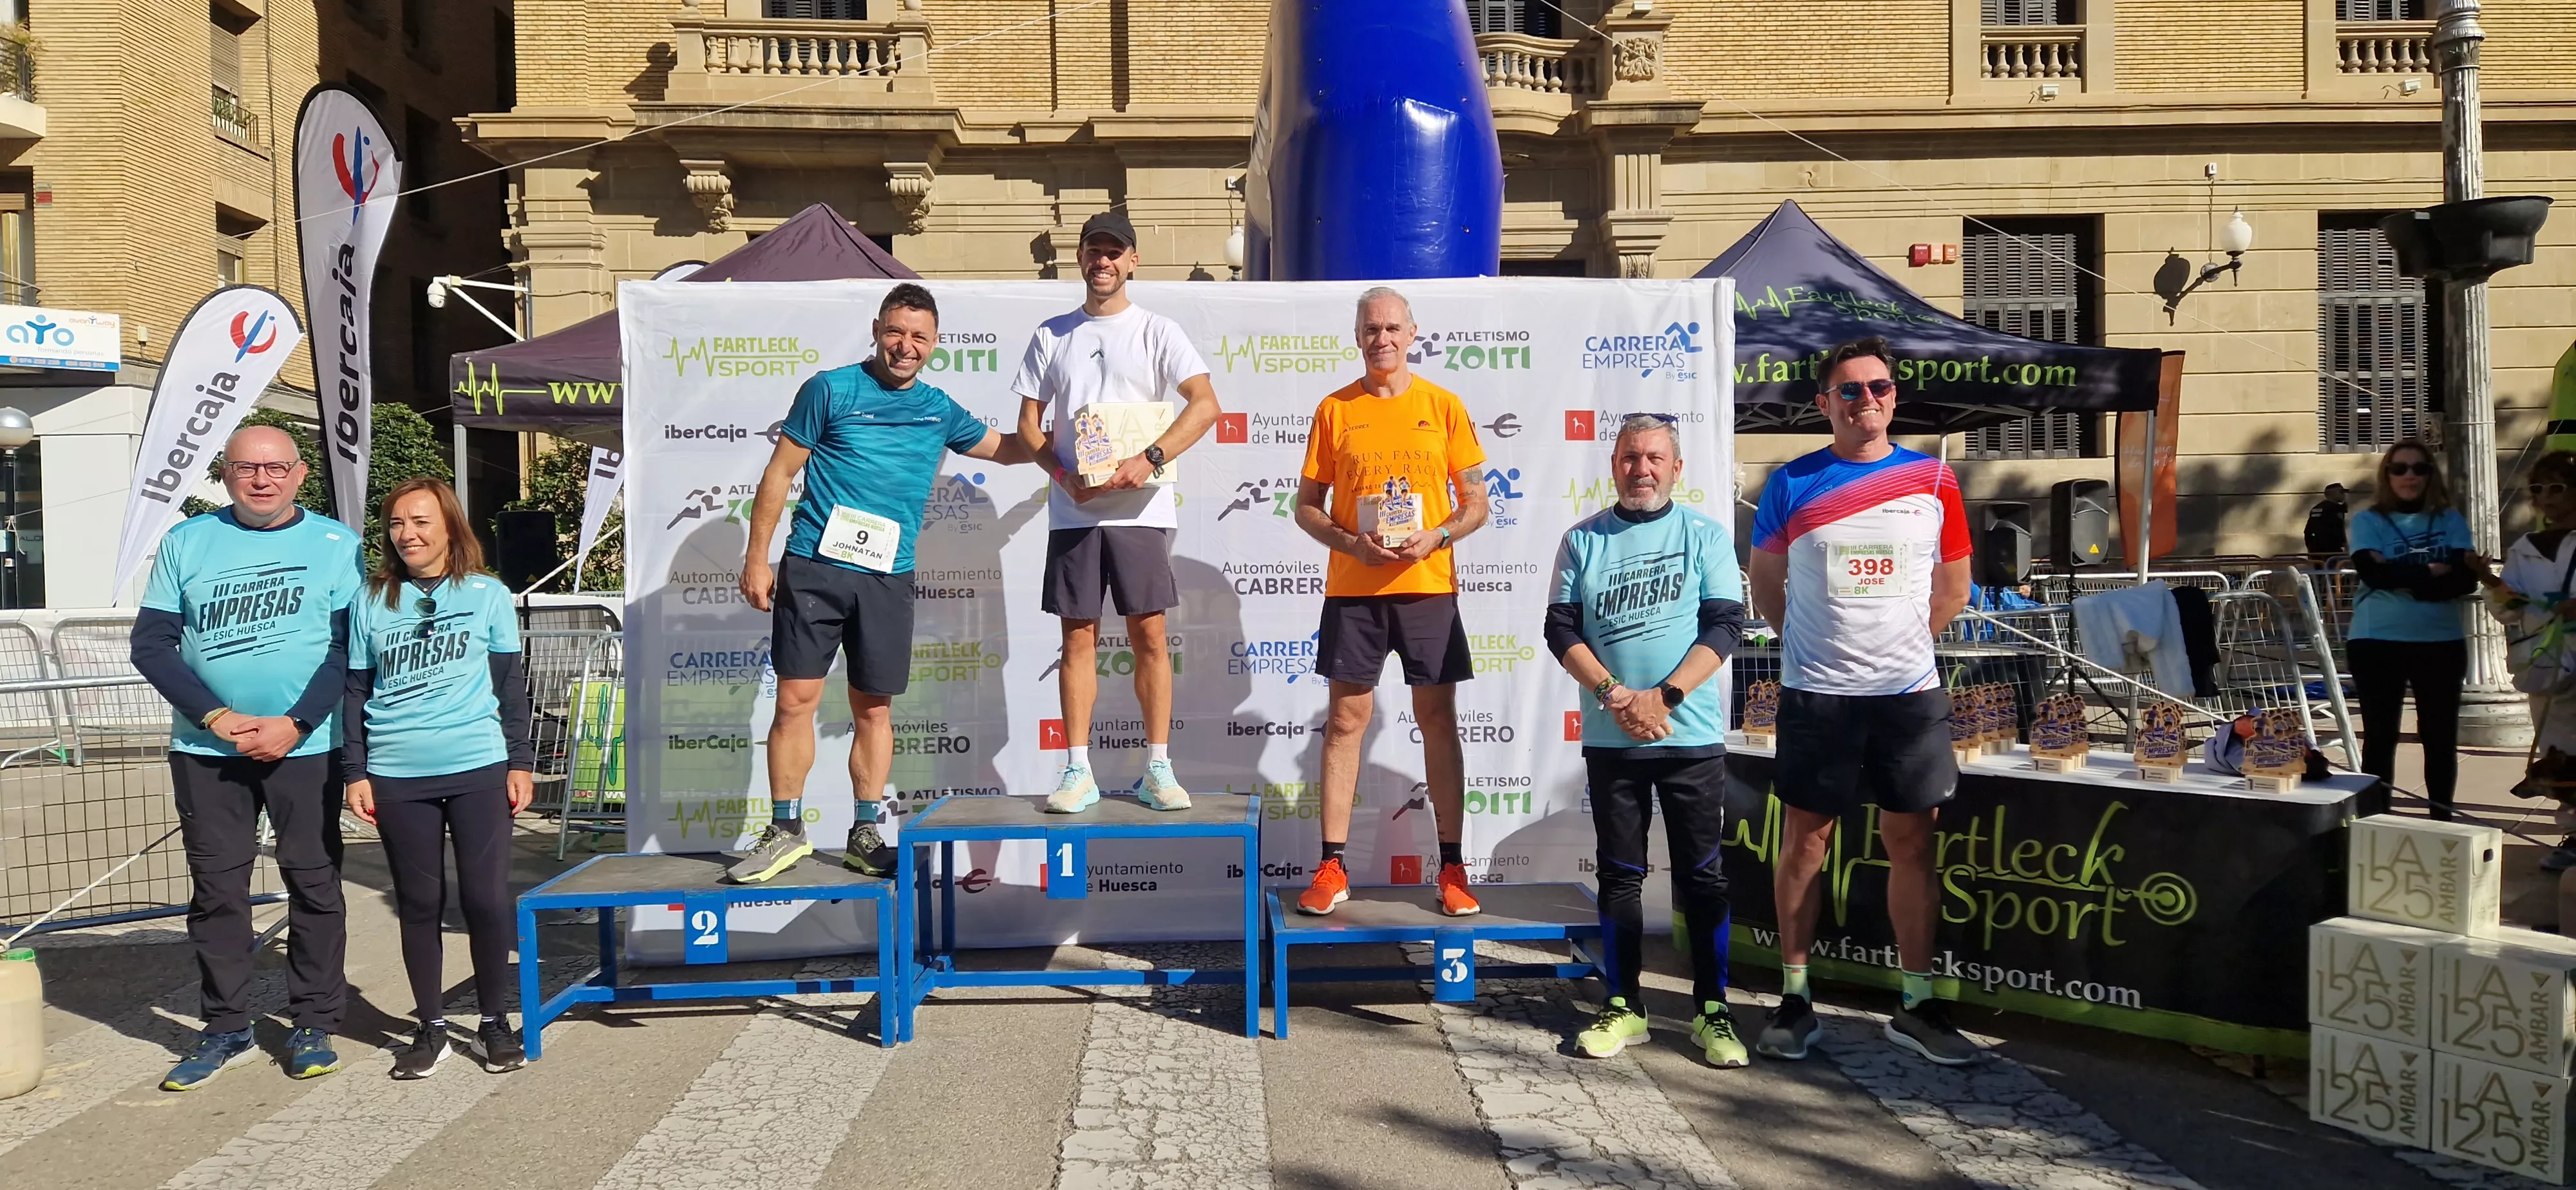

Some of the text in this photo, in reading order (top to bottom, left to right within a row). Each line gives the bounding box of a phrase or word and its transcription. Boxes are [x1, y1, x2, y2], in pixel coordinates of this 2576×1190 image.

[938, 333, 997, 344] ETISMO
[1260, 335, 1340, 351] FARTLECK
[1446, 330, 1530, 342] ATLETISMO
[1585, 335, 1685, 352] CARRERA
[329, 243, 359, 464] Ibercaja
[714, 337, 799, 353] FARTLECK
[917, 348, 998, 373] OITI
[1264, 357, 1341, 373] SPORT
[1444, 345, 1531, 372] ZOITI
[1582, 352, 1685, 370] EMPRESAS
[717, 361, 800, 377] SPORT
[1665, 372, 1675, 381] By
[1252, 413, 1315, 430] Ayunta
[141, 372, 241, 504] Ibercaja
[664, 424, 748, 443] iberCaja
[1252, 430, 1269, 444] de
[1599, 428, 1617, 441] de
[1085, 446, 1113, 464] EMPRESAS
[1352, 450, 1432, 465] RUN FAST
[1090, 473, 1096, 484] 1
[1347, 464, 1392, 480] EVERY
[857, 515, 886, 527] CARRERA
[1386, 510, 1415, 524] EMPRESAS
[948, 524, 958, 532] By
[855, 530, 869, 545] 9
[1385, 535, 1391, 546] 3
[832, 541, 884, 560] JOHNATAN
[840, 550, 855, 560] 8K
[914, 567, 1001, 581] untamiento
[1222, 560, 1320, 574] Automóviles
[1608, 563, 1666, 587] III CARRERA
[1848, 558, 1894, 576] 398
[670, 569, 742, 584] Automóv
[213, 577, 285, 598] III CARRERA
[915, 586, 975, 599] Huesca
[1235, 578, 1327, 596] CABRER
[1458, 579, 1512, 592] Huesca
[1854, 587, 1869, 595] 8K
[1595, 572, 1683, 621] EMPRESAS
[199, 585, 305, 634] EMPRESAS
[1609, 606, 1661, 627] ESIC HUESCA
[213, 620, 276, 641] ESIC HUESCA
[386, 631, 401, 647] III
[911, 641, 981, 657] ARTLECK
[1230, 641, 1319, 657] CARRER
[1468, 634, 1517, 650] TLECK
[670, 650, 772, 668] CARRERA
[1471, 657, 1517, 673] ORT
[388, 666, 444, 689] ESIC HUESCA
[667, 668, 775, 686] EMPRESAS
[1311, 677, 1321, 686] By
[754, 689, 764, 698] By
[1227, 721, 1305, 739] iberCaja
[668, 734, 748, 753] iberCaja
[893, 736, 971, 755] BRERO
[1099, 737, 1148, 749] Huesc
[1745, 735, 1749, 745] 1
[2038, 737, 2072, 747] EMPRESAS
[2143, 745, 2179, 755] EMPRESAS
[2034, 760, 2039, 771] 1
[2253, 754, 2290, 764] EMPRESAS
[1464, 776, 1531, 788] LETISMO
[2140, 769, 2145, 780] 1
[2248, 779, 2253, 790] 1
[1464, 790, 1531, 815] OITI
[1861, 800, 2127, 887] Frtleck
[1056, 843, 1075, 876] 1
[2371, 830, 2430, 883] LA
[1086, 861, 1183, 877] yuntamiento
[1099, 880, 1157, 892] Huesca
[2358, 864, 2434, 920] 125
[2438, 856, 2458, 925] AMBAR
[1941, 865, 2133, 950] Sport
[691, 910, 719, 946] 2
[1441, 948, 1468, 983] 3
[2329, 936, 2389, 995] LA
[2453, 959, 2521, 1019] LA
[2316, 969, 2394, 1032] 125
[2398, 967, 2416, 1037] AMBAR
[2439, 994, 2524, 1059] 125
[2528, 990, 2550, 1065] AMBAR
[2330, 1035, 2392, 1095] LA
[2317, 1068, 2395, 1131] 125
[2398, 1069, 2418, 1139] AMBAR
[2454, 1064, 2523, 1128] LA
[2441, 1098, 2525, 1166] 125
[2530, 1100, 2551, 1175] AMBAR
